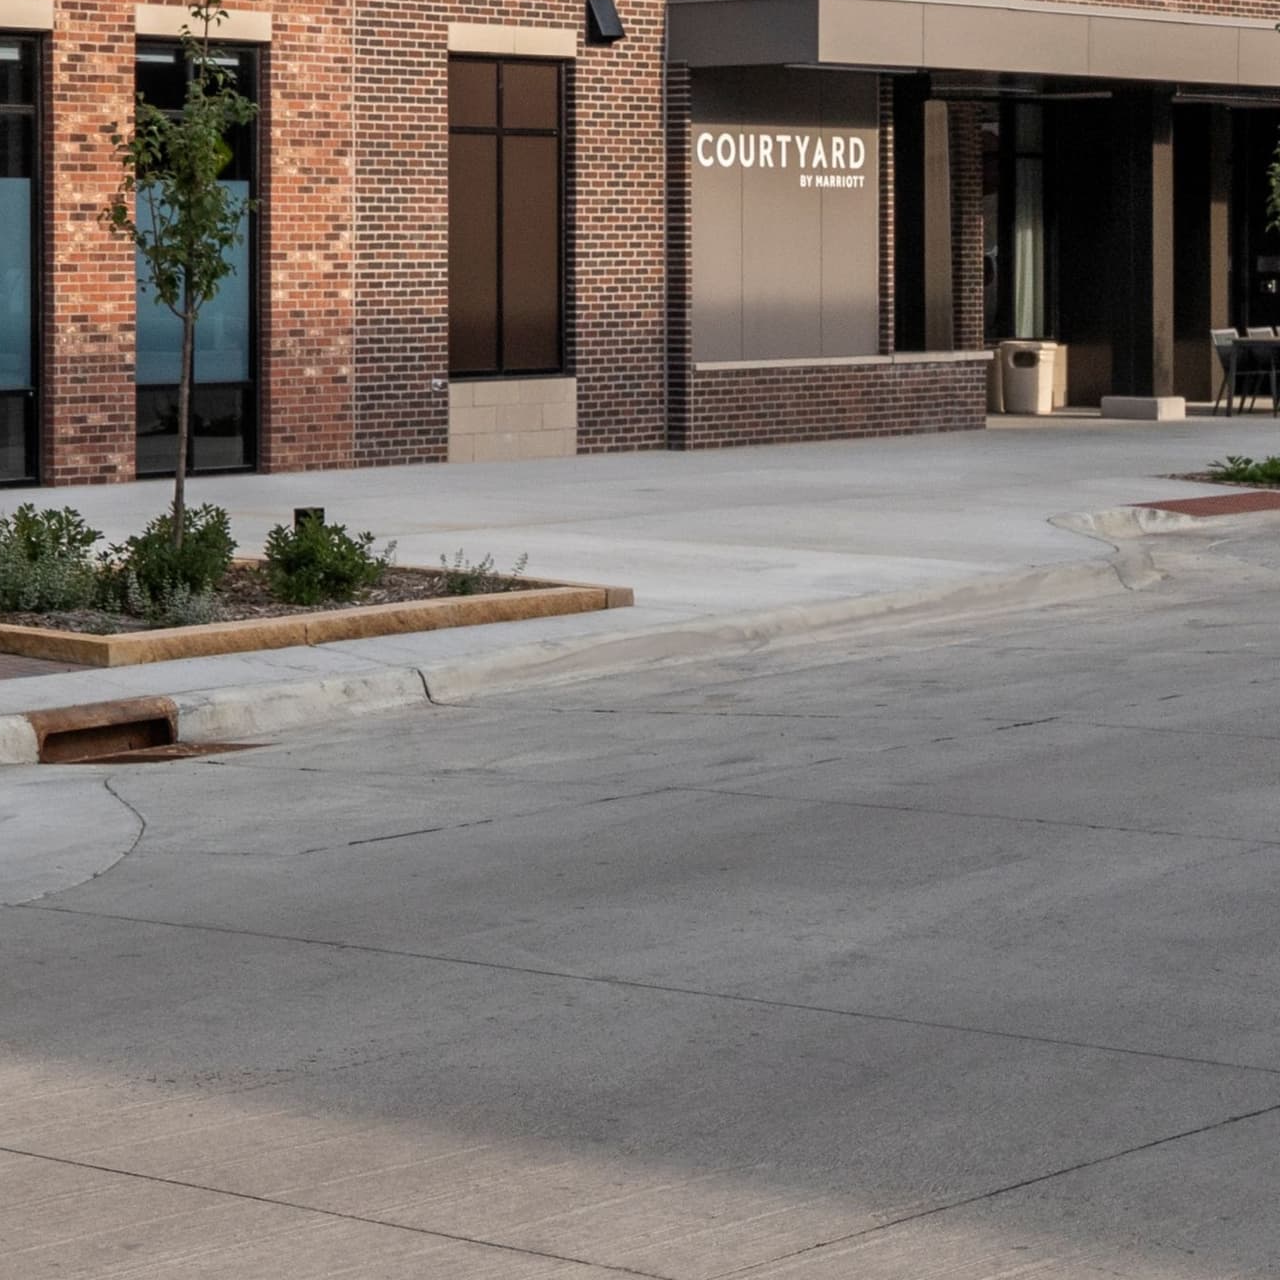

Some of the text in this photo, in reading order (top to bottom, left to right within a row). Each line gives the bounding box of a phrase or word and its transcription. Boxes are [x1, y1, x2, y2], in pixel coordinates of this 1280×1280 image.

[696, 132, 866, 169] COURTYARD
[800, 175, 866, 188] BY MARRIOTT
